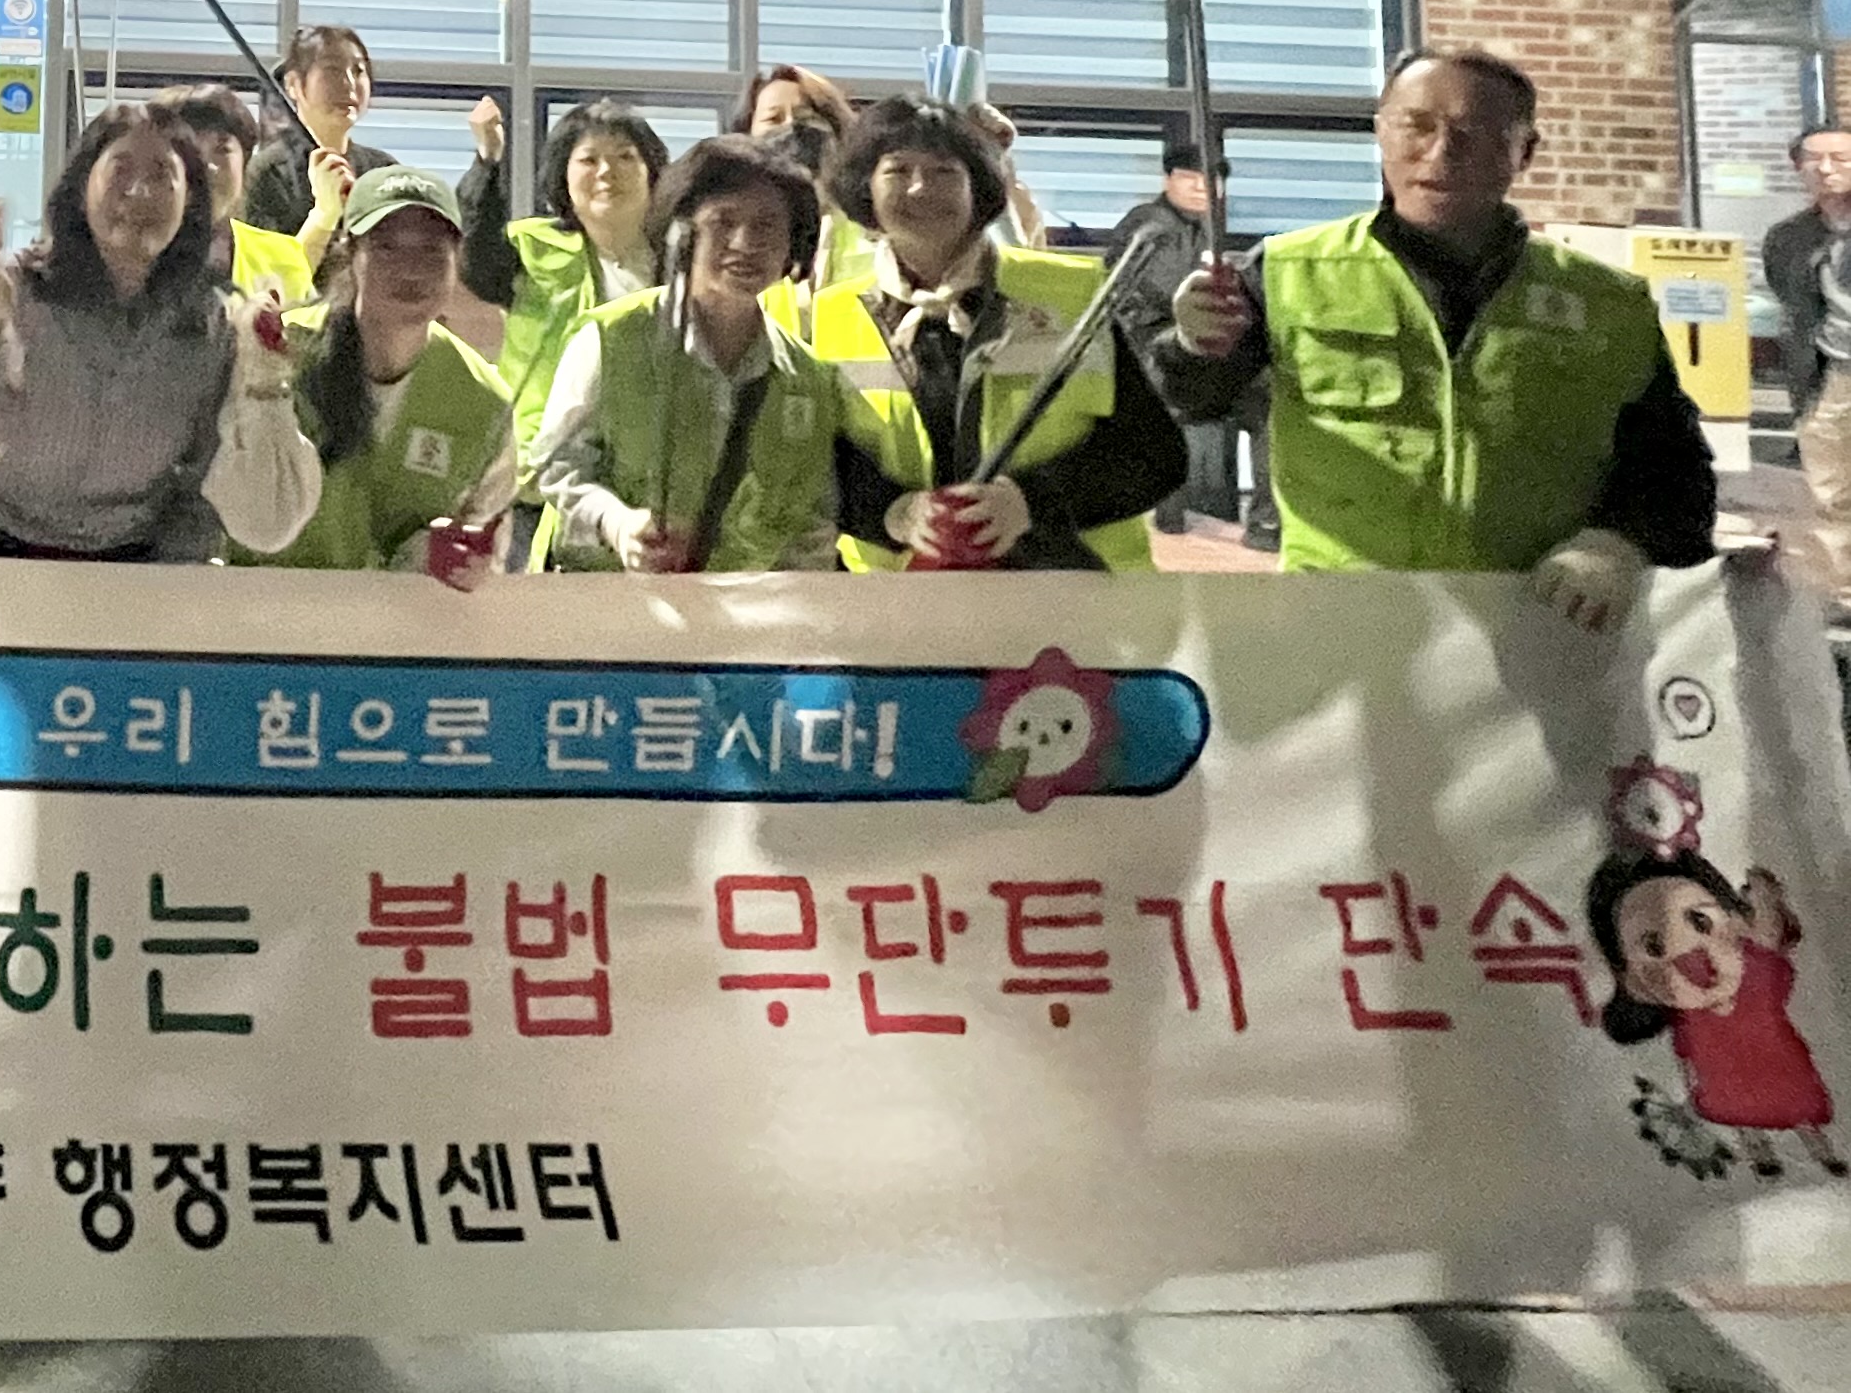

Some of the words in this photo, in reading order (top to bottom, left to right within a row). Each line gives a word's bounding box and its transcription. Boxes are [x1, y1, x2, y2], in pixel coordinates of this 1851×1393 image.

[39, 685, 193, 764] 우리
[256, 690, 492, 771] 힘으로
[546, 695, 899, 780] 만듭시다!
[355, 871, 612, 1037] 불법
[714, 874, 1247, 1034] 무단투기
[1320, 871, 1604, 1033] 단속
[50, 1137, 621, 1252] 행정복지센터
